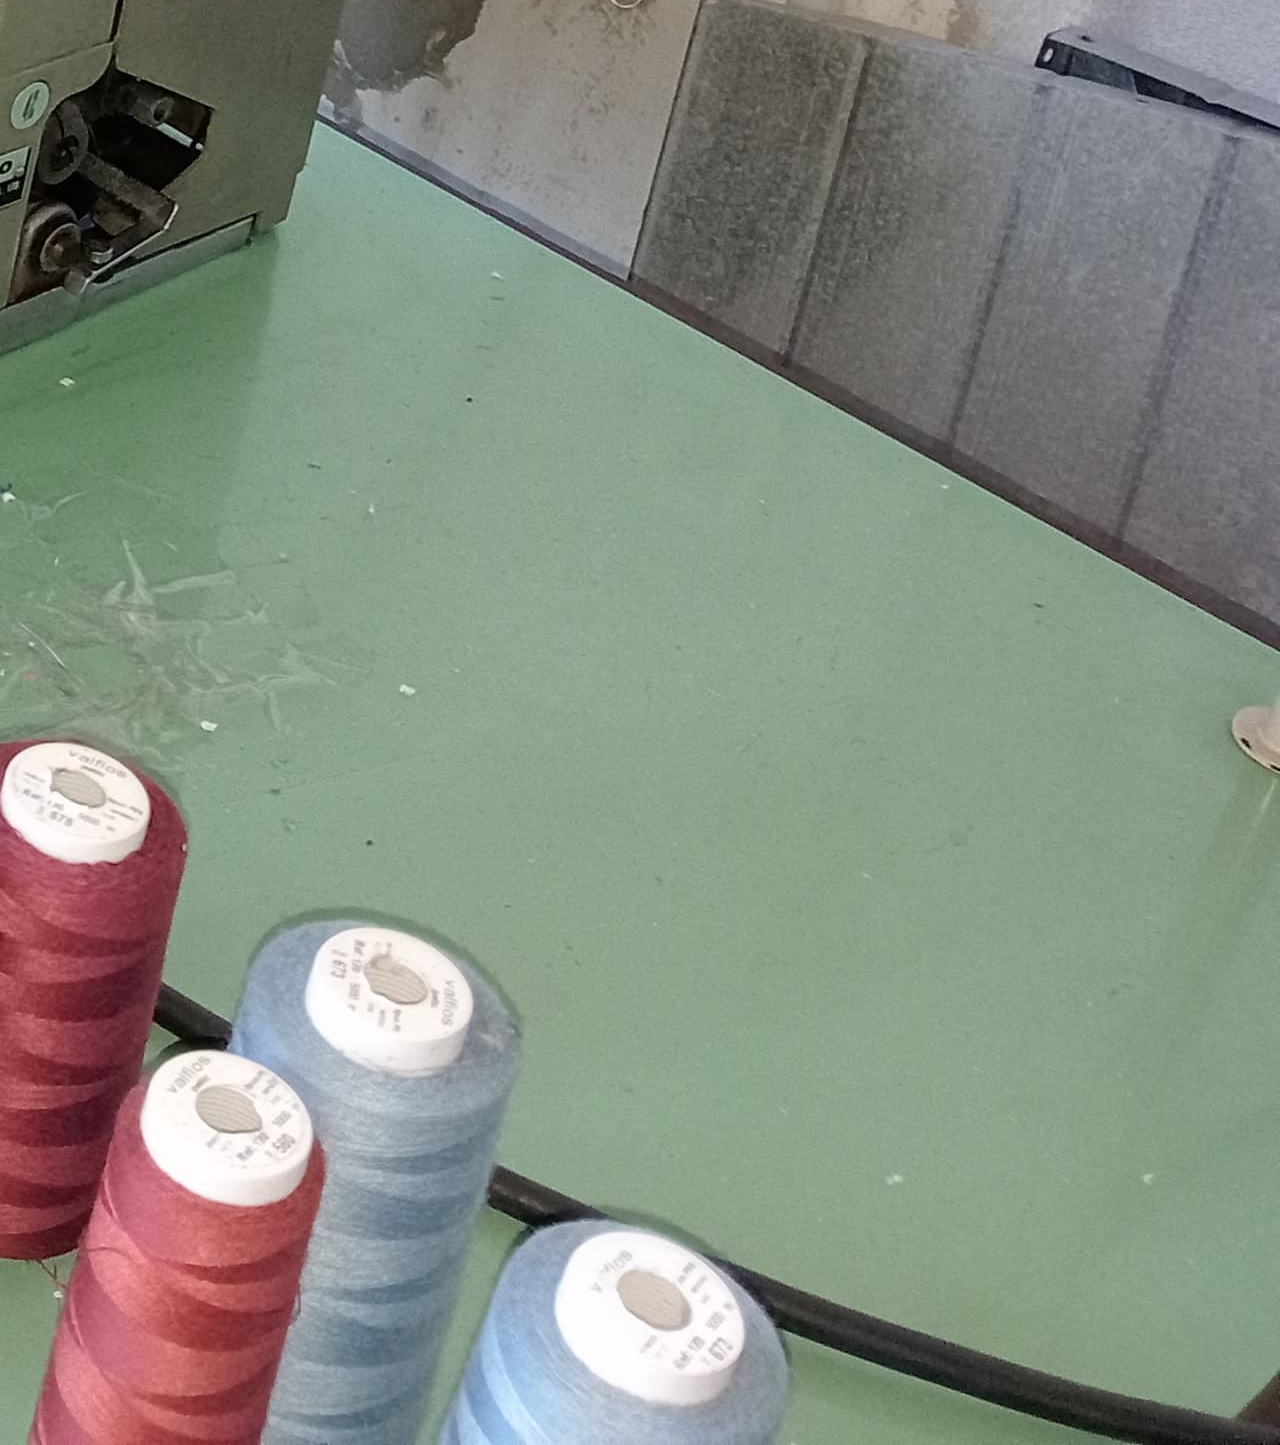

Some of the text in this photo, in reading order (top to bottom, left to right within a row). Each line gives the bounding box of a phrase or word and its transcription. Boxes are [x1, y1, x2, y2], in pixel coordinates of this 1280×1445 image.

[441, 980, 458, 1027] valfios
[165, 1056, 211, 1094] valfios
[590, 1250, 633, 1293] vfios
